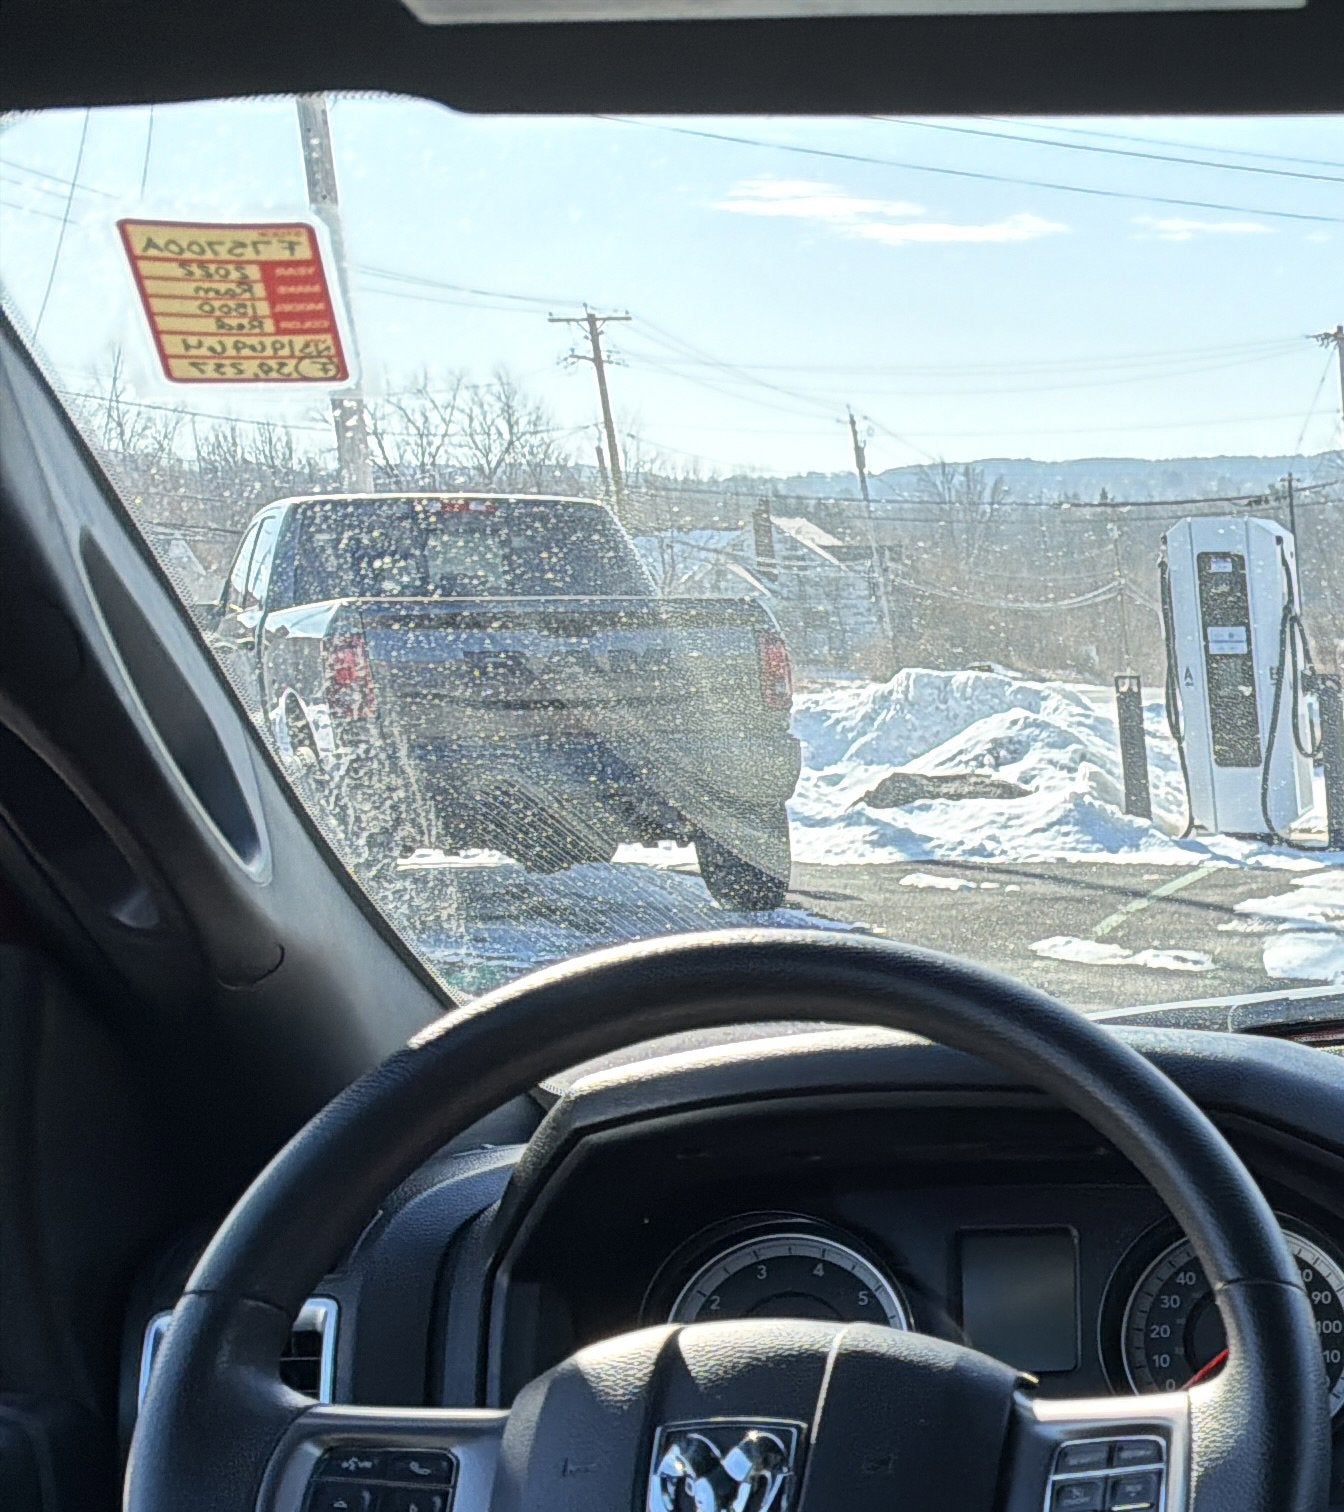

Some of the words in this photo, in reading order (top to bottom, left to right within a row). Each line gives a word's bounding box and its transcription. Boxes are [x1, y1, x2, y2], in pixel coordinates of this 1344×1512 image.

[1184, 666, 1194, 681] A
[756, 1265, 768, 1279] 3
[813, 1263, 825, 1277] 4
[1176, 1272, 1196, 1285] 40
[710, 1296, 721, 1310] 2
[858, 1291, 869, 1306] 5
[1160, 1295, 1180, 1308] 30
[1311, 1291, 1332, 1304] 90
[1151, 1325, 1170, 1338] 20
[1316, 1321, 1342, 1334] 100
[1152, 1354, 1170, 1367] 10
[1166, 1379, 1176, 1392] 0
